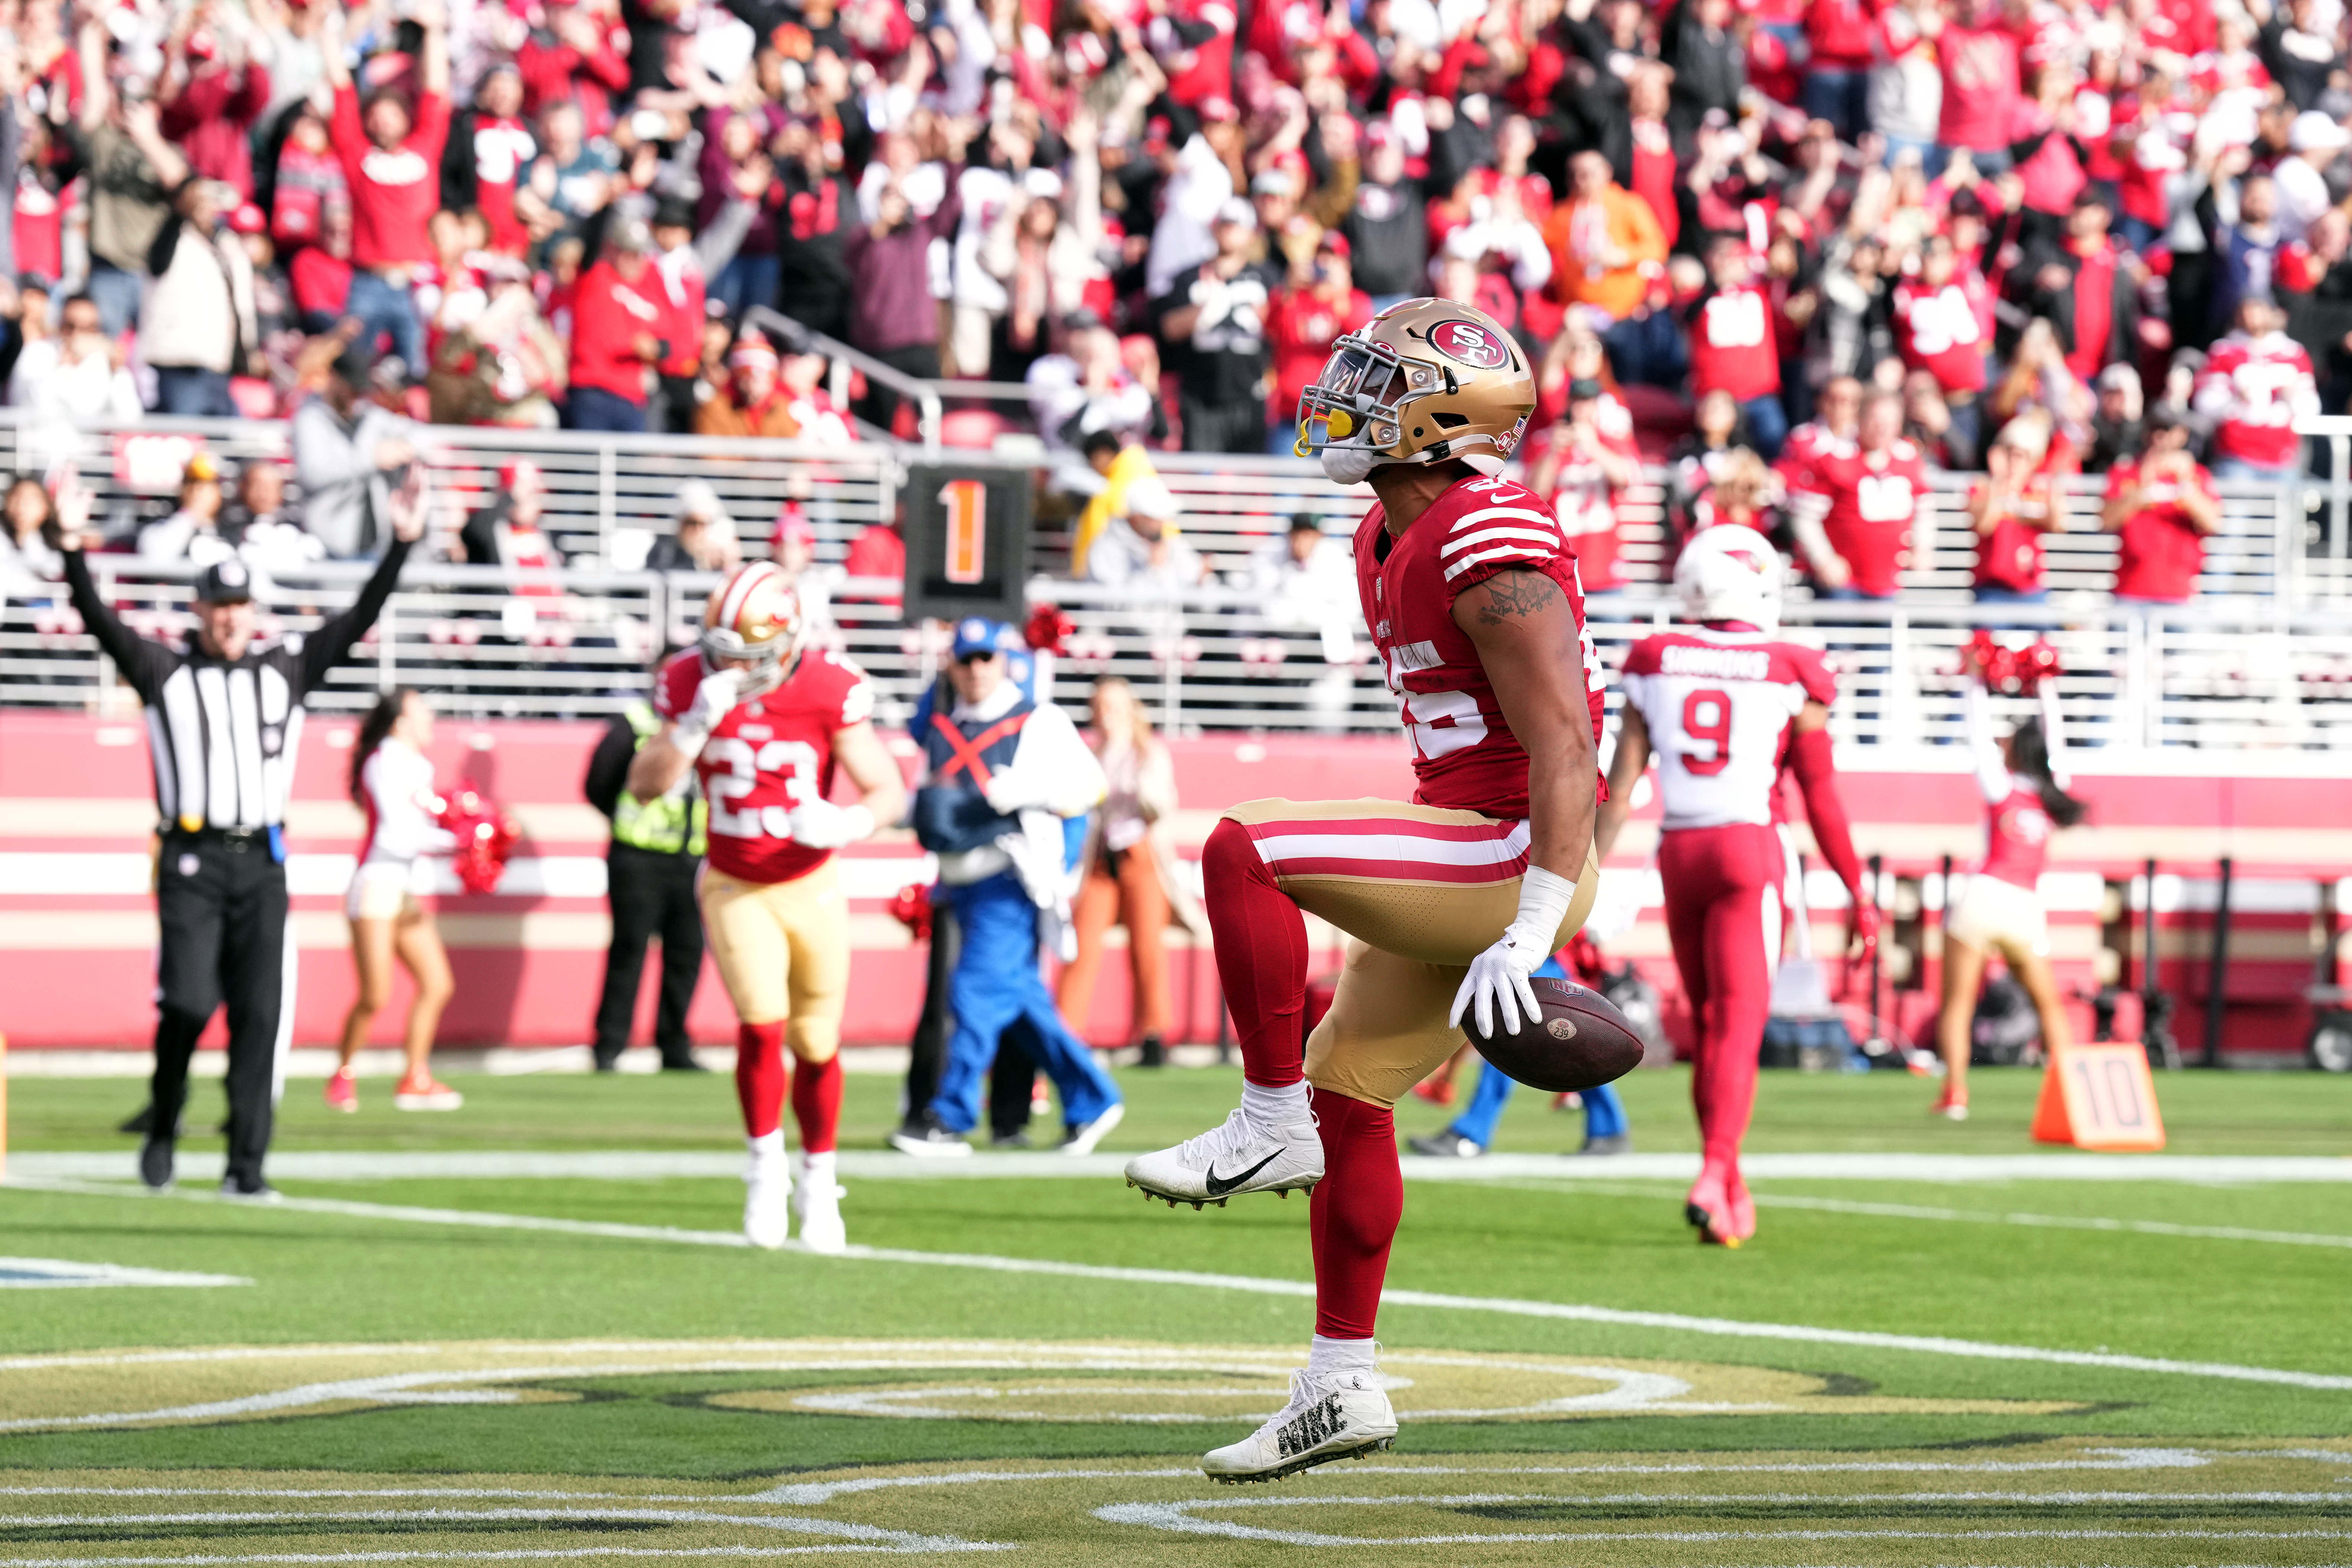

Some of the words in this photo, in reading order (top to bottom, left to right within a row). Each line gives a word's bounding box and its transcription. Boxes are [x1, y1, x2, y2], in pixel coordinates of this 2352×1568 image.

[1452, 325, 1497, 362] SF
[936, 479, 986, 584] 1
[1682, 689, 1732, 775] 9
[702, 737, 819, 838] 23
[1553, 981, 1581, 994] NFL
[2077, 1060, 2142, 1126] 10
[1277, 1392, 1348, 1459] NIKE
